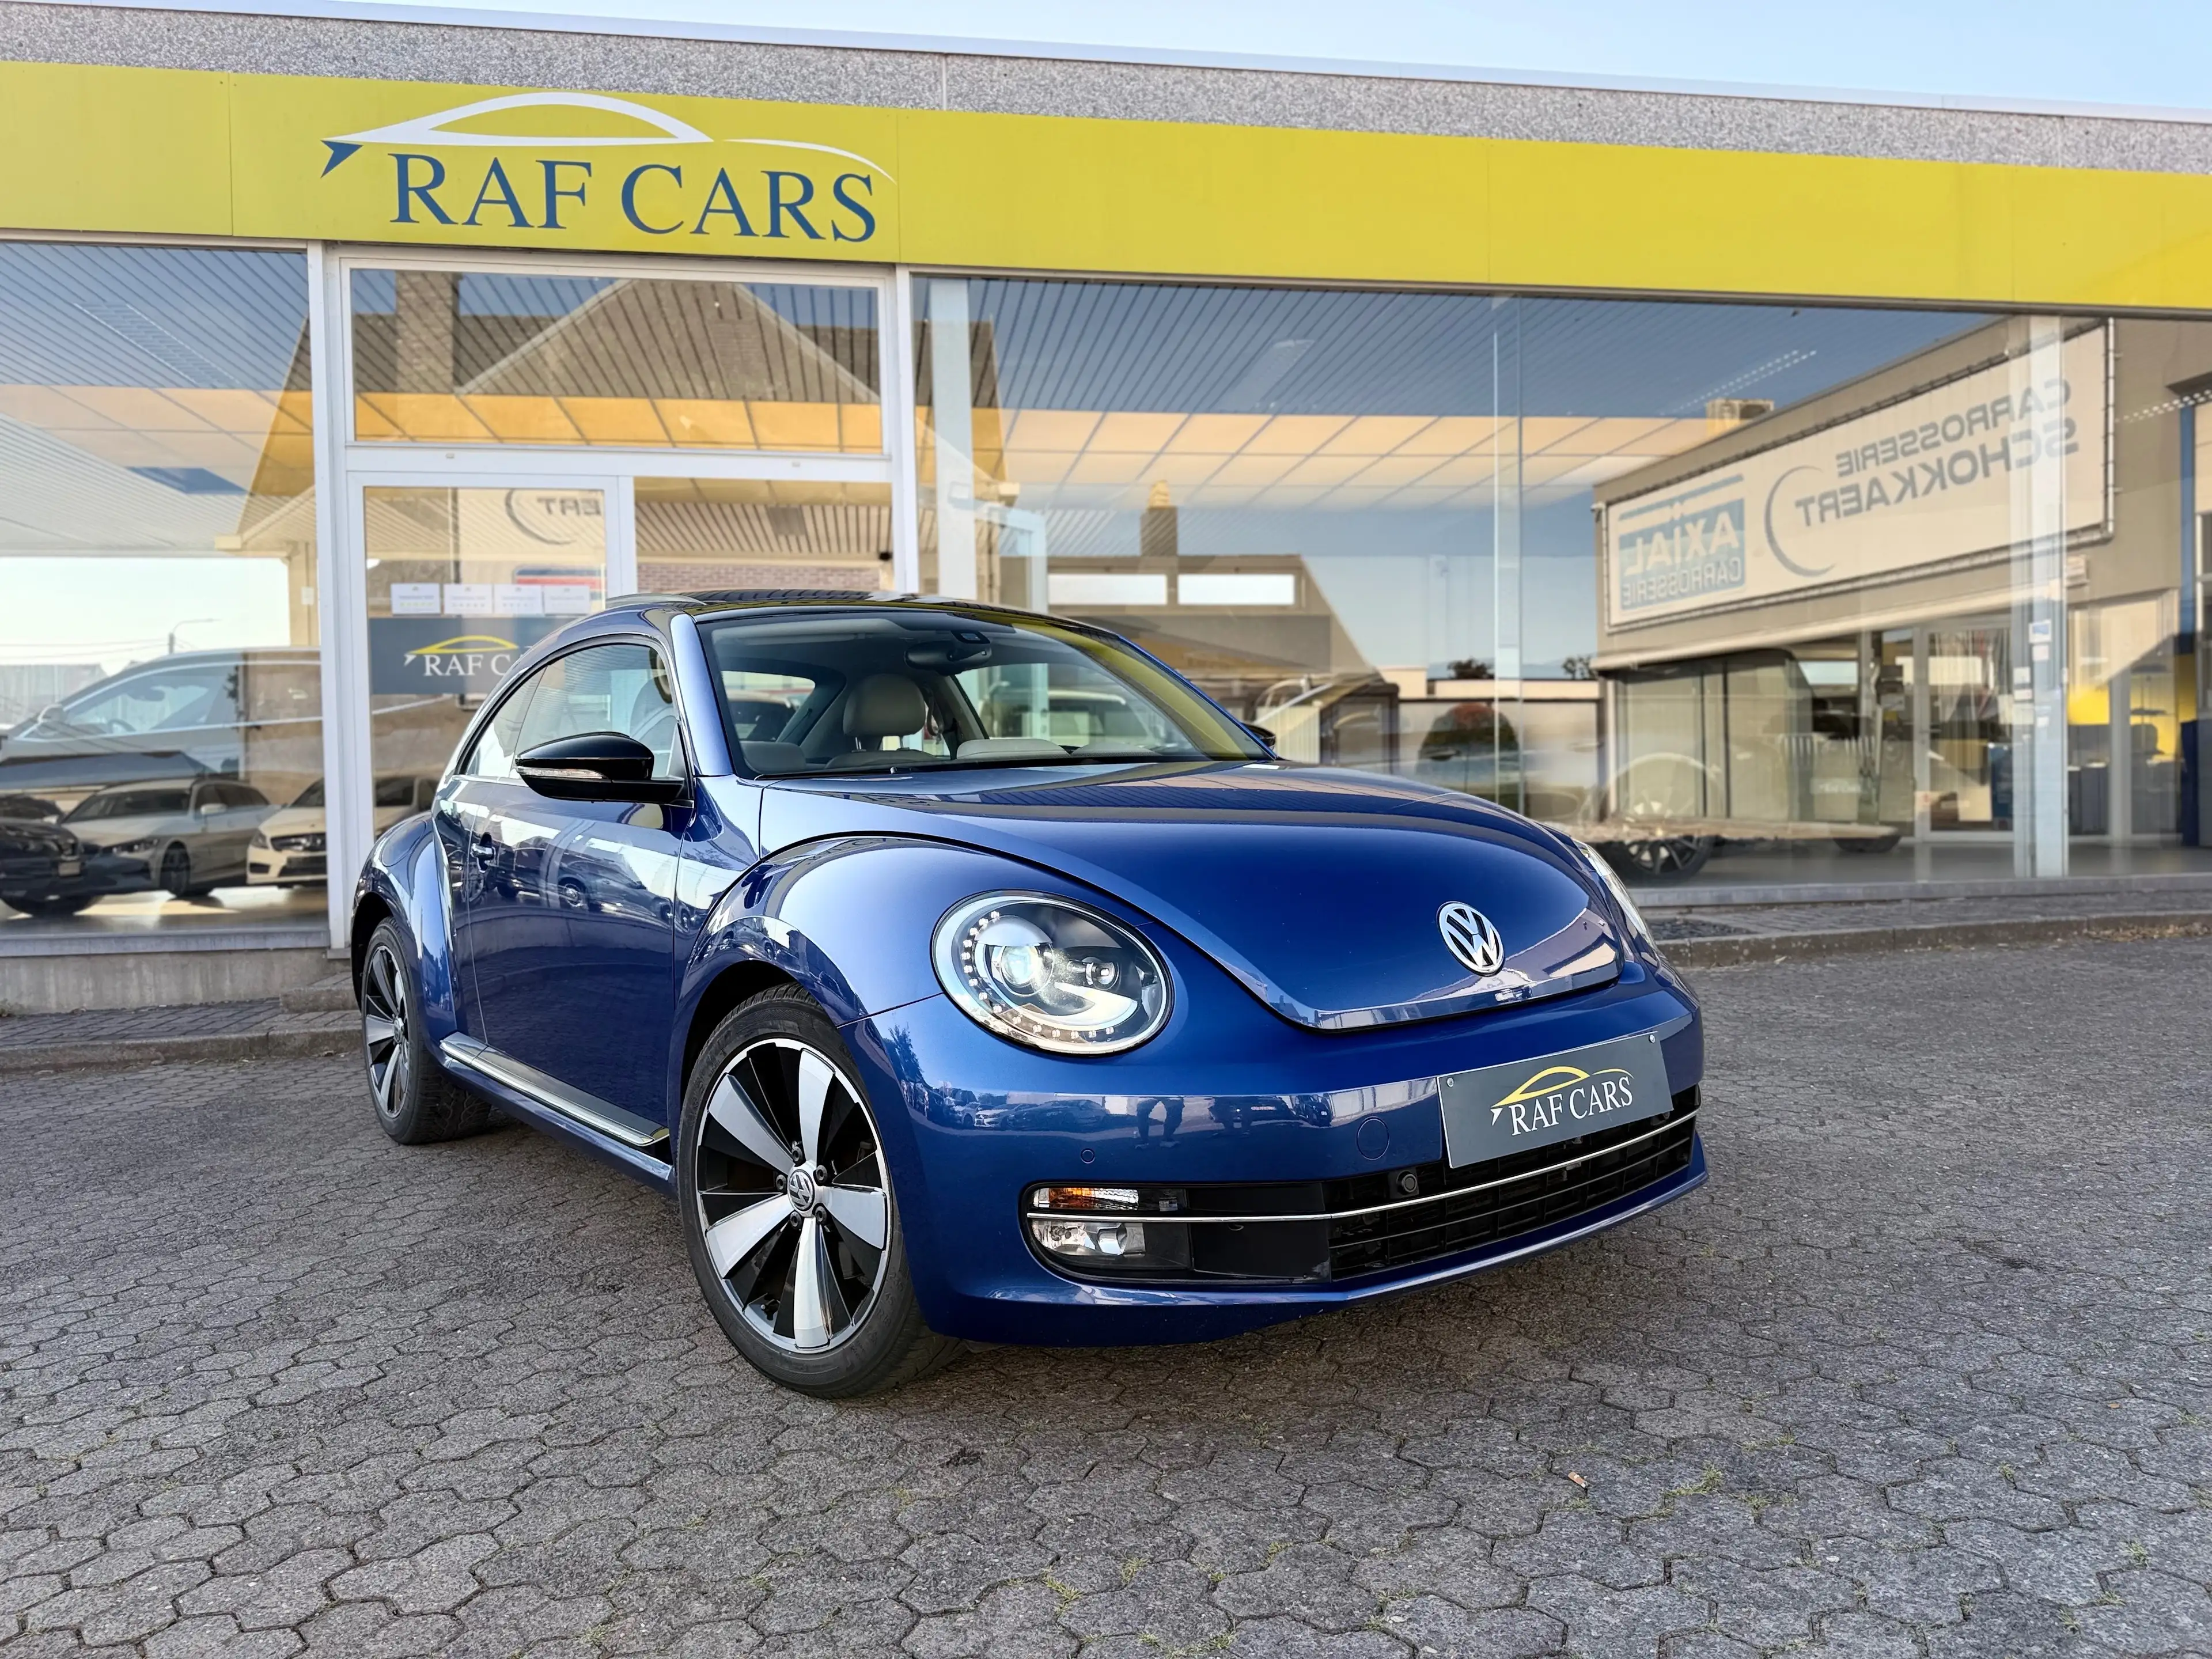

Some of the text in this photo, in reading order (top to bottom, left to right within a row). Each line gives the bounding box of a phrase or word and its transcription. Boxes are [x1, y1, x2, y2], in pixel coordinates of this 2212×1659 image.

[387, 152, 877, 243] RAF CARS
[423, 654, 484, 676] RAF
[1509, 1077, 1633, 1137] RAF CARS
